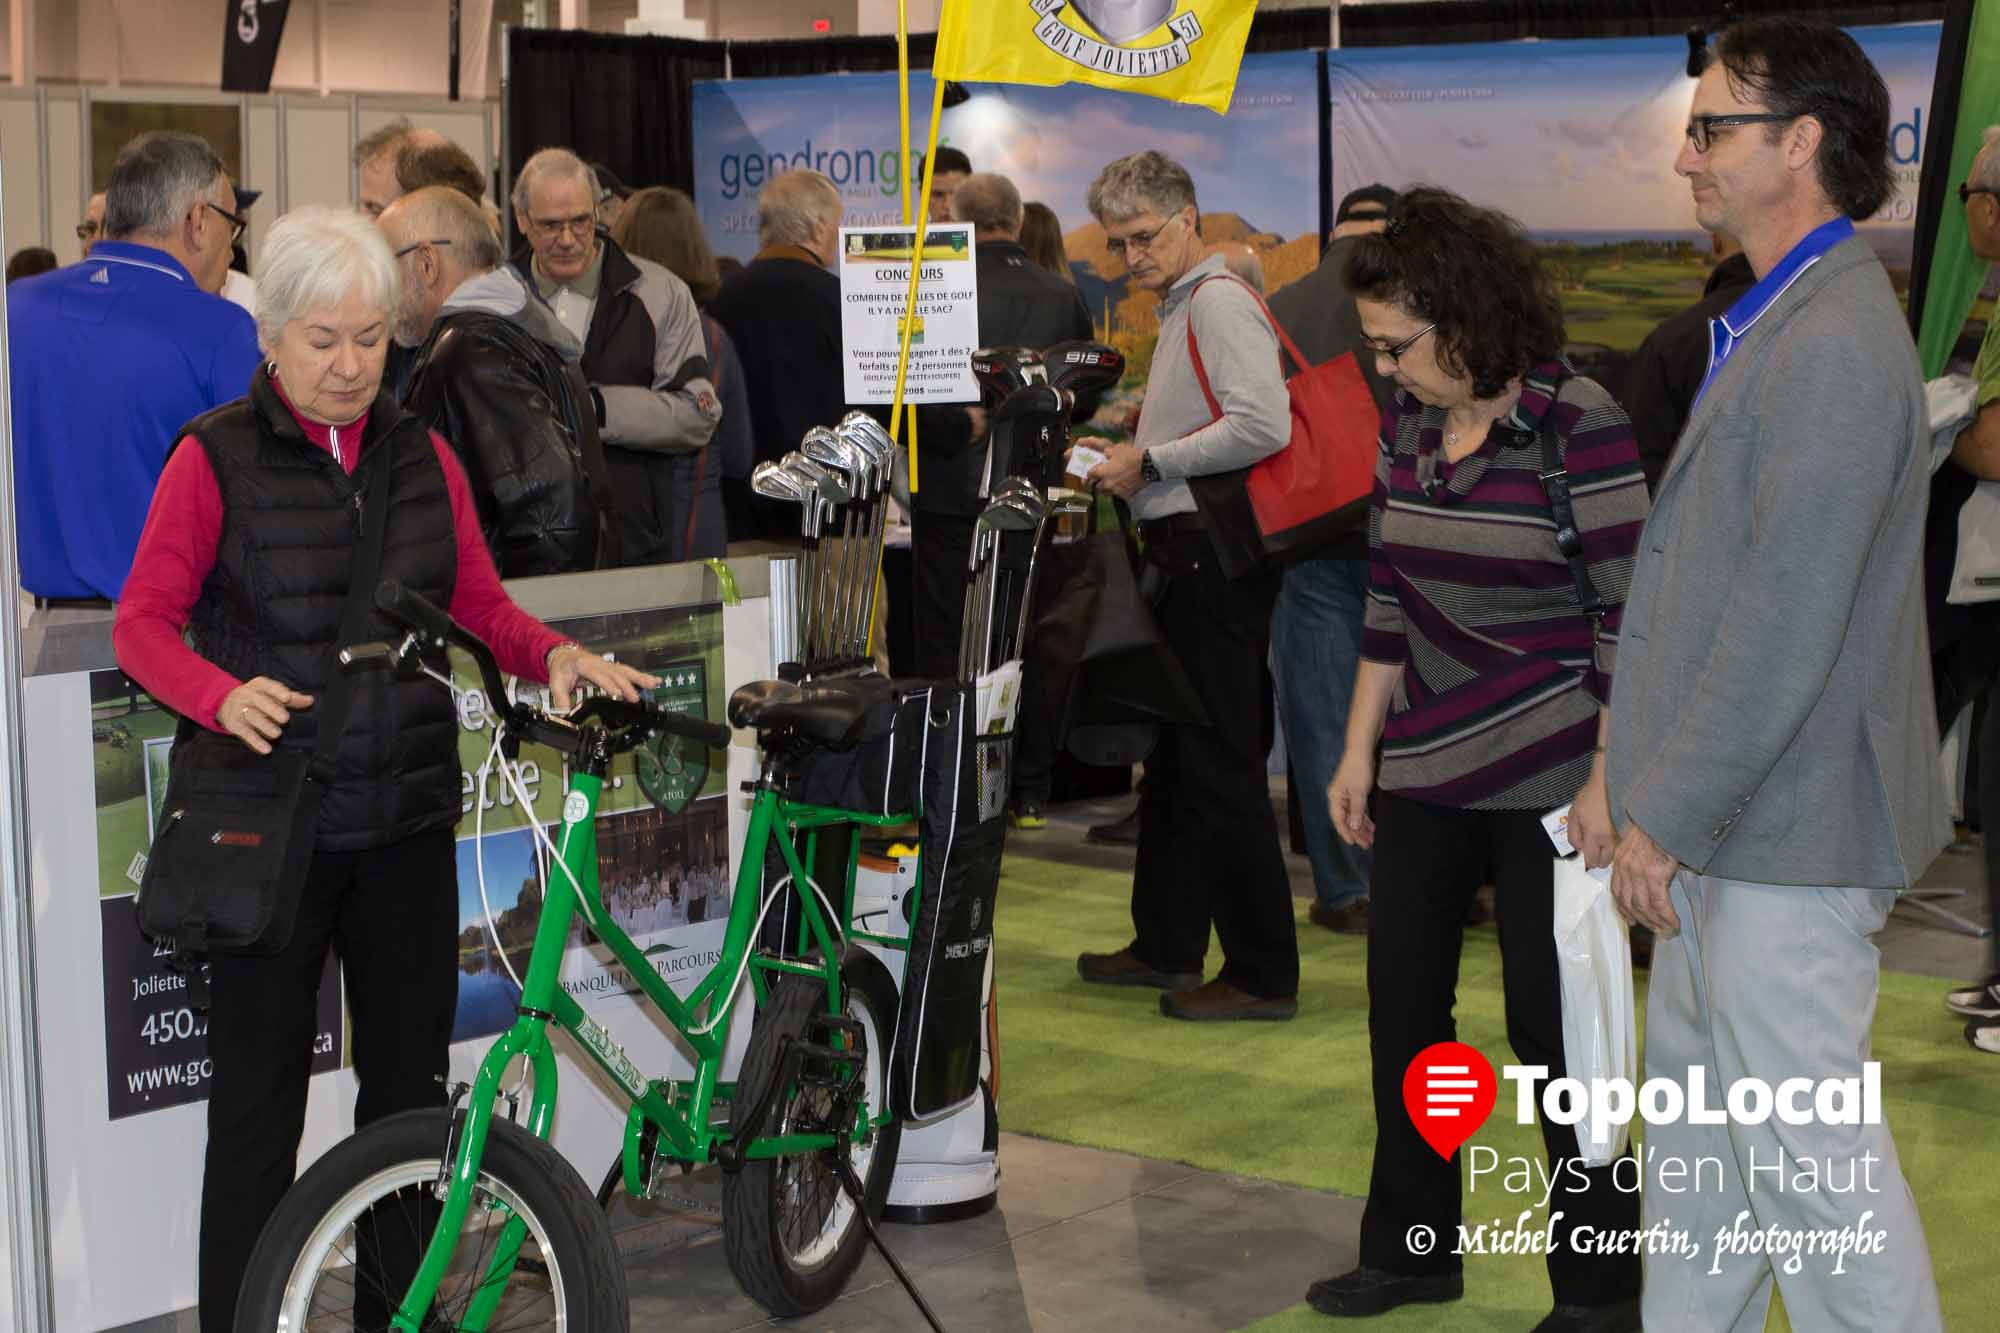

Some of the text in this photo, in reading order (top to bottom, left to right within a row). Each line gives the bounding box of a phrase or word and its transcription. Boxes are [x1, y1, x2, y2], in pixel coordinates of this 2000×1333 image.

[1181, 17, 1198, 39] 51
[1041, 21, 1183, 74] GOLF JOLIETTE
[875, 268, 944, 282] CONCURS
[846, 292, 889, 303] COMBIEN
[891, 292, 901, 302] DE
[937, 291, 948, 301] DE
[951, 290, 974, 300] GOLF
[931, 303, 953, 314] SAC?
[852, 348, 874, 359] Vous
[910, 349, 938, 361] gagner
[948, 347, 963, 356] des
[859, 361, 890, 372] forfaits
[914, 361, 920, 370] 2
[922, 360, 968, 373] personnes
[656, 950, 722, 977] PARCOURS
[131, 974, 187, 1001] Joliette
[140, 1008, 208, 1045] 450.
